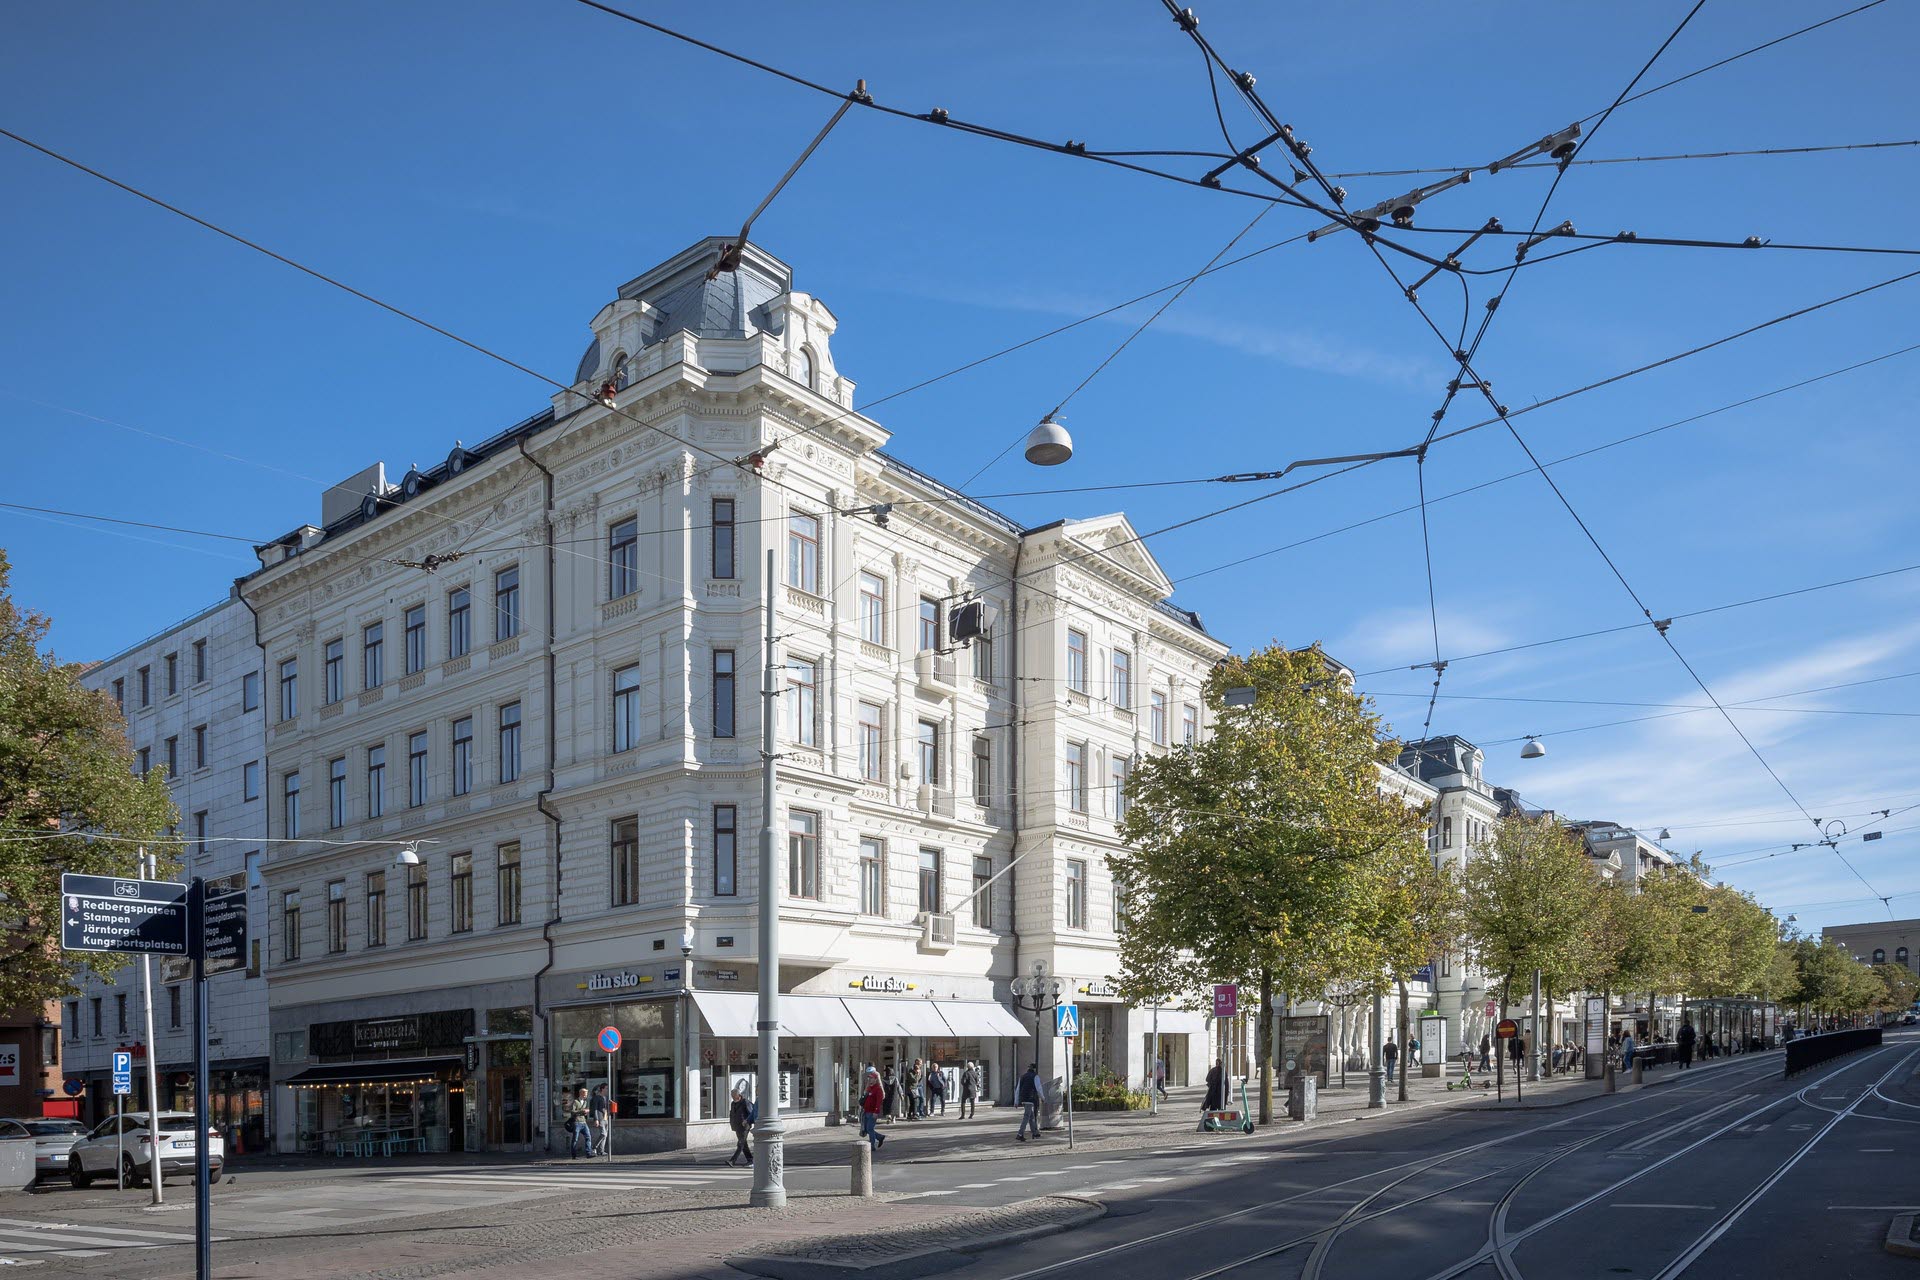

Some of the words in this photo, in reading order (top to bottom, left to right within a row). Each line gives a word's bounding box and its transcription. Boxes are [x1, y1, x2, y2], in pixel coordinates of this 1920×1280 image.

[83, 900, 176, 916] Redbergsplatsen
[83, 912, 131, 924] Stampen
[83, 924, 141, 937] Järntorget
[205, 927, 220, 936] Haga
[83, 936, 183, 950] Kungsportsplatsen
[588, 974, 613, 990] din
[613, 971, 638, 988] sko
[863, 975, 886, 990] din
[886, 977, 907, 991] sko
[1090, 982, 1104, 995] din
[357, 1023, 417, 1041] KEBABERIA
[117, 1054, 128, 1072] P
